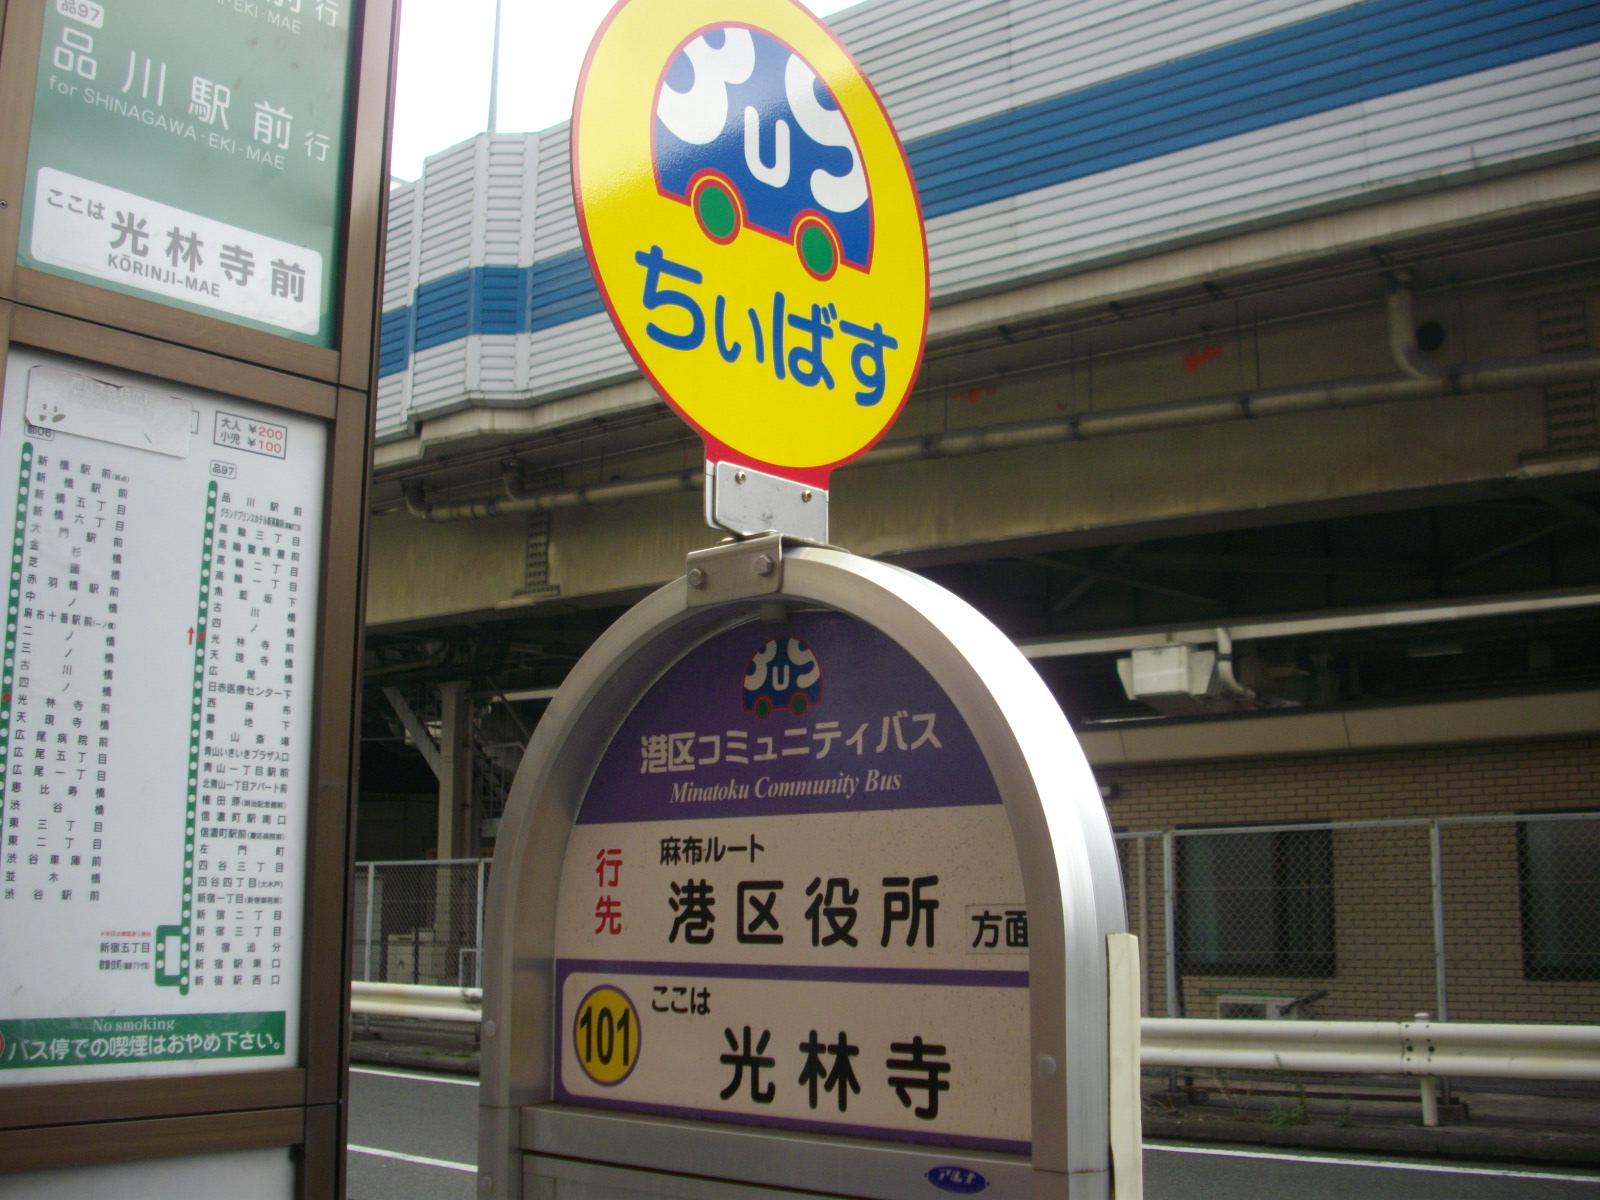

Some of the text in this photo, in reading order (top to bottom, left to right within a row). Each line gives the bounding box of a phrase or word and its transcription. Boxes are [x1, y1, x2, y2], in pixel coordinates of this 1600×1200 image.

[49, 75, 78, 96] for
[47, 188, 306, 303] ここは 光林寺前
[635, 245, 898, 406] ちいばす
[221, 418, 241, 432] 大人
[213, 463, 234, 475] 品97
[36, 472, 128, 499] 新橋駅前
[35, 489, 126, 515] 新橋五丁目
[222, 492, 303, 516] 品川駅前
[33, 506, 124, 531] 新橋六丁目
[32, 523, 123, 548] 大門駅前
[219, 523, 300, 547] 高輪三丁目
[30, 540, 121, 564] 金杉橋
[217, 554, 298, 577] 高輪二丁目
[27, 574, 119, 597] 赤羽橋駅前
[215, 570, 298, 592] 高輪一丁目
[213, 602, 296, 623] 古川橋
[211, 634, 294, 654] 光林寺前
[210, 649, 293, 669] 天現寺橋
[20, 660, 113, 680] 古川橋
[209, 666, 293, 684] 広尾橋
[208, 682, 292, 700] 日赤医療センター下
[18, 695, 110, 714] 光林寺前
[207, 698, 291, 715] 西麻布
[16, 712, 109, 731] 天現寺橋
[15, 730, 108, 748] 広尾病院前
[641, 711, 942, 774] 港区コミュニティバス
[14, 748, 107, 765] 広尾五丁目
[13, 765, 106, 782] 広尾一丁目
[203, 762, 289, 778] 青山一丁目駅前
[11, 782, 105, 799] 恵比寿橋
[670, 770, 901, 804] Minatoku Community Bus
[10, 800, 104, 815] 渋谷橋
[9, 818, 103, 832] 東三丁目
[8, 835, 102, 850] 東二丁目
[199, 844, 284, 857] 左門町
[659, 835, 765, 865] 麻布ルート
[6, 854, 101, 867] 渋谷車庫前
[198, 860, 284, 873] 四谷三丁目
[6, 871, 100, 884] 並木橋
[5, 889, 100, 901] 渋谷駅前
[595, 848, 623, 935] 行先
[197, 909, 282, 921] 新宿二丁目
[668, 875, 1029, 947] 港区役所 方面
[196, 926, 281, 937] 新宿三丁目
[100, 942, 150, 954] 新宿五丁目
[195, 959, 280, 970] 新宿駅東口
[195, 975, 280, 986] 新宿駅西口
[651, 986, 711, 1015] ここは
[93, 1019, 175, 1032] No smoking
[580, 1005, 630, 1067] 101
[720, 1025, 951, 1120] 光林寺
